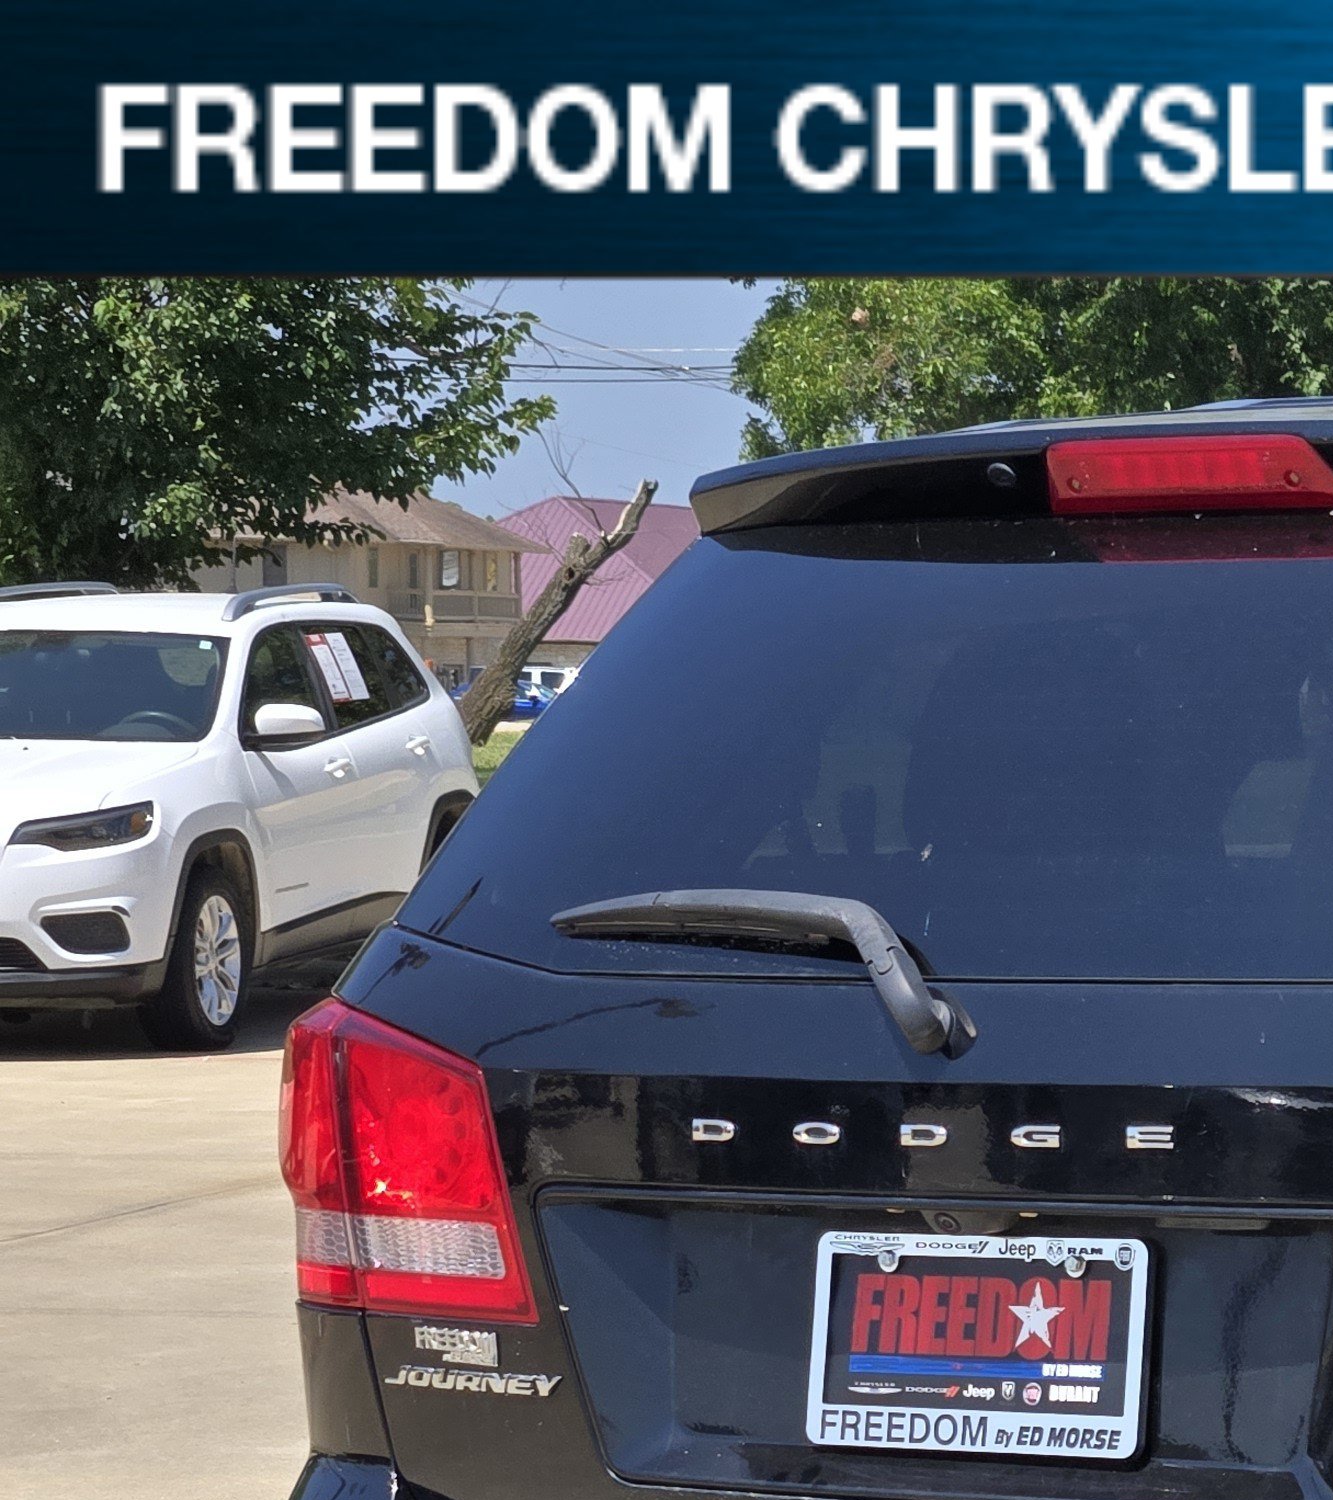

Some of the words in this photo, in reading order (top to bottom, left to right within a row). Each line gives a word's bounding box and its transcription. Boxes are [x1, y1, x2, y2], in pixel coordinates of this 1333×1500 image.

[693, 1118, 1175, 1150] DODGE
[833, 1233, 901, 1242] CHRYSLER
[914, 1241, 979, 1251] DODGE
[998, 1238, 1036, 1259] Jeep
[1066, 1246, 1104, 1256] RAM
[850, 1273, 1112, 1361] FREEDOM
[384, 1364, 563, 1397] JOURNEY
[962, 1383, 996, 1401] Jeep
[819, 1409, 988, 1448] FREEDOM
[994, 1429, 1014, 1448] By
[1016, 1426, 1043, 1447] ED
[1046, 1427, 1122, 1450] MORSE
